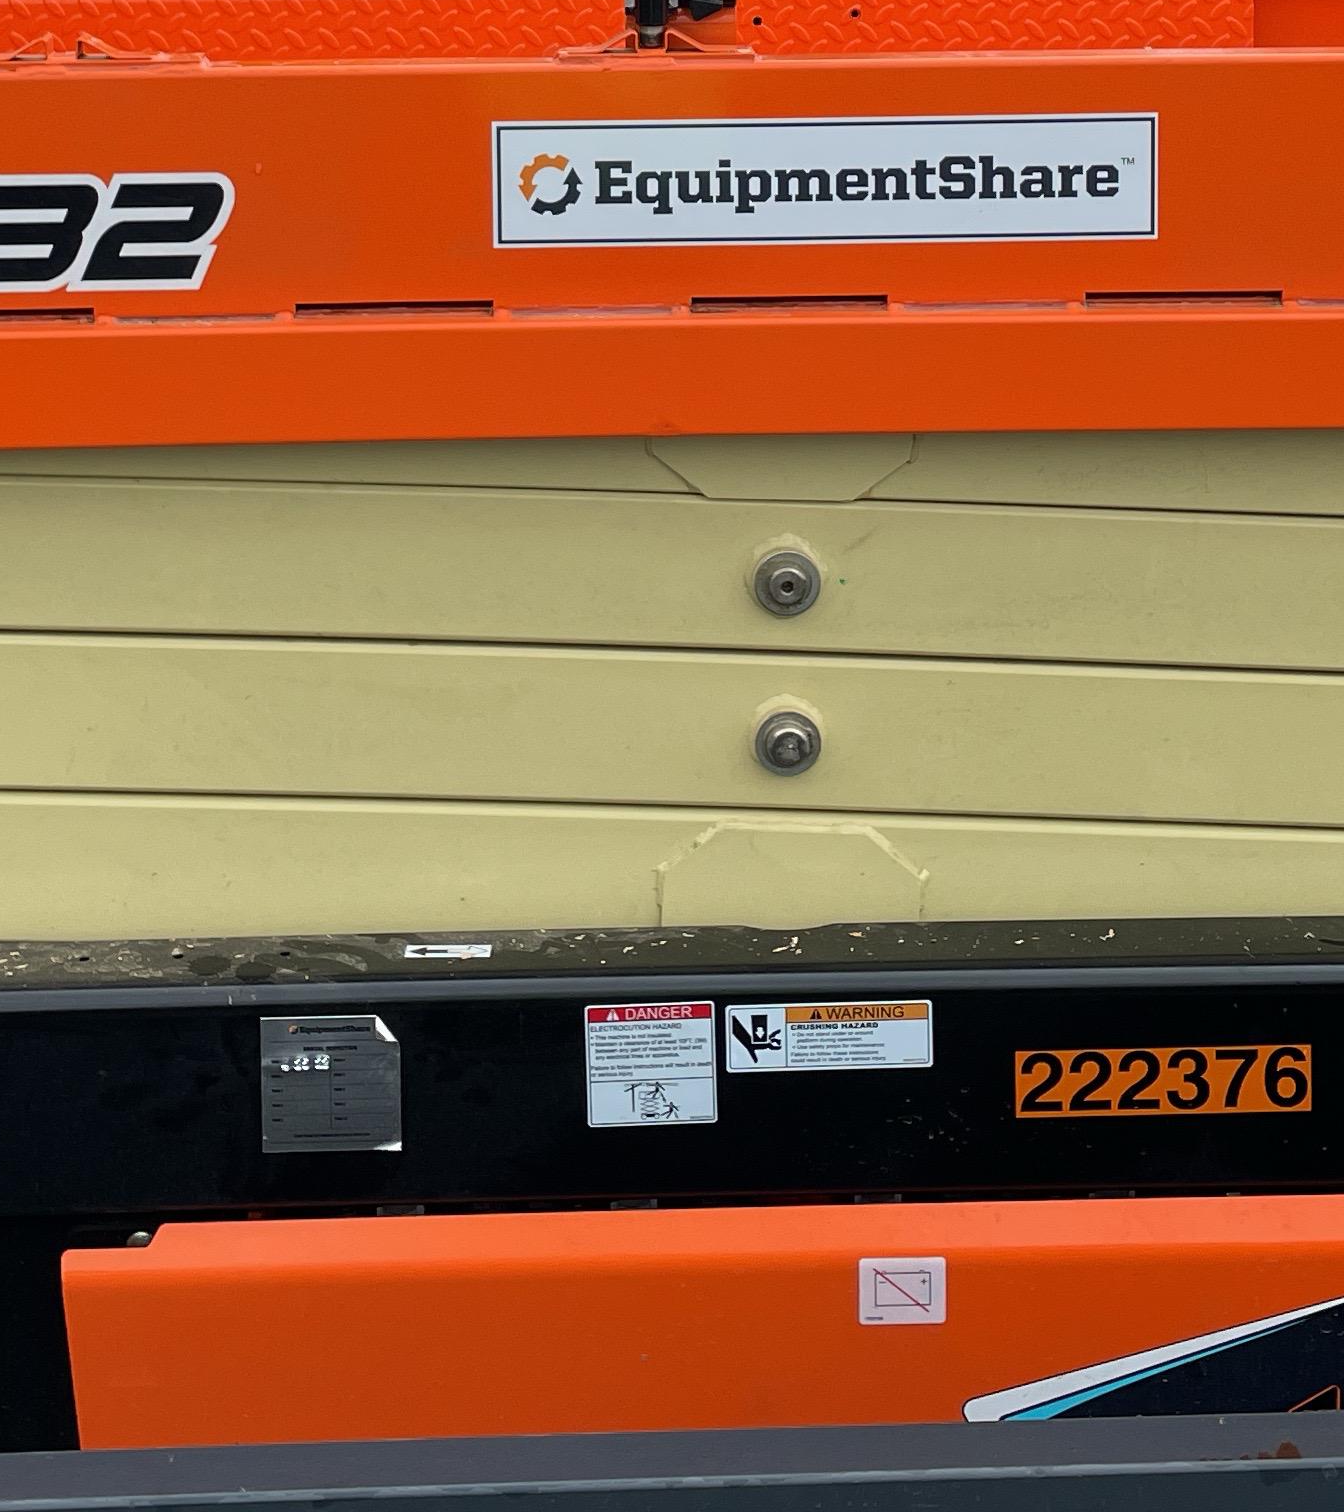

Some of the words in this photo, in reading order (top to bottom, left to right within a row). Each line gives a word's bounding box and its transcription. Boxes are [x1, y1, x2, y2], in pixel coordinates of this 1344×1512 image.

[625, 1006, 693, 1020] DANGER
[826, 1006, 904, 1019] WARNING
[591, 1023, 651, 1032] ELECTROCUTION
[1020, 1047, 1308, 1112] 222376
